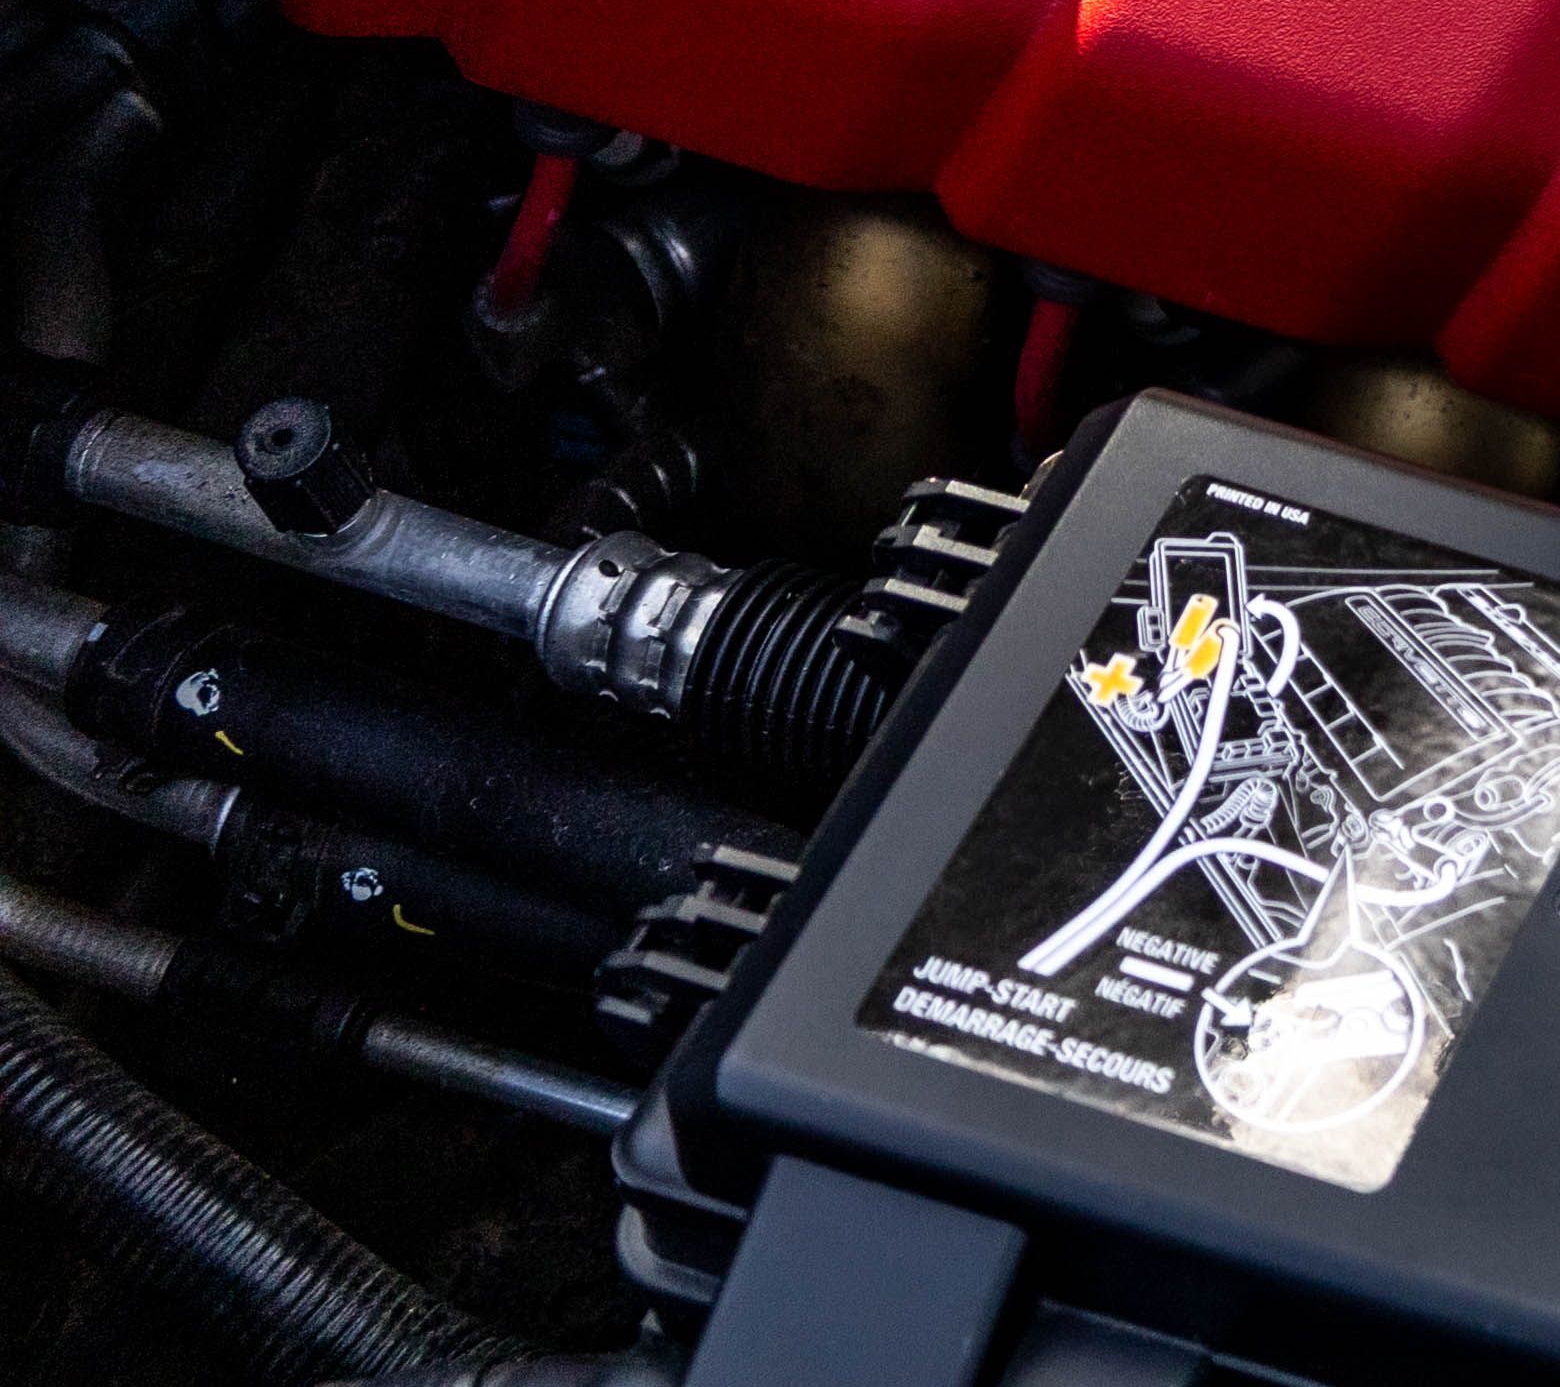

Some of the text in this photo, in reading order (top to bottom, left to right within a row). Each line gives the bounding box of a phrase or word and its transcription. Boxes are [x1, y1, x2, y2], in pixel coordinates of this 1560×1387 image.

[1206, 483, 1311, 525] PRINTED IN USA
[1115, 927, 1221, 975] NEGATIVE
[913, 955, 1076, 1023] JUMP-START
[893, 986, 1176, 1095] DEMARRAGE-SECOURS
